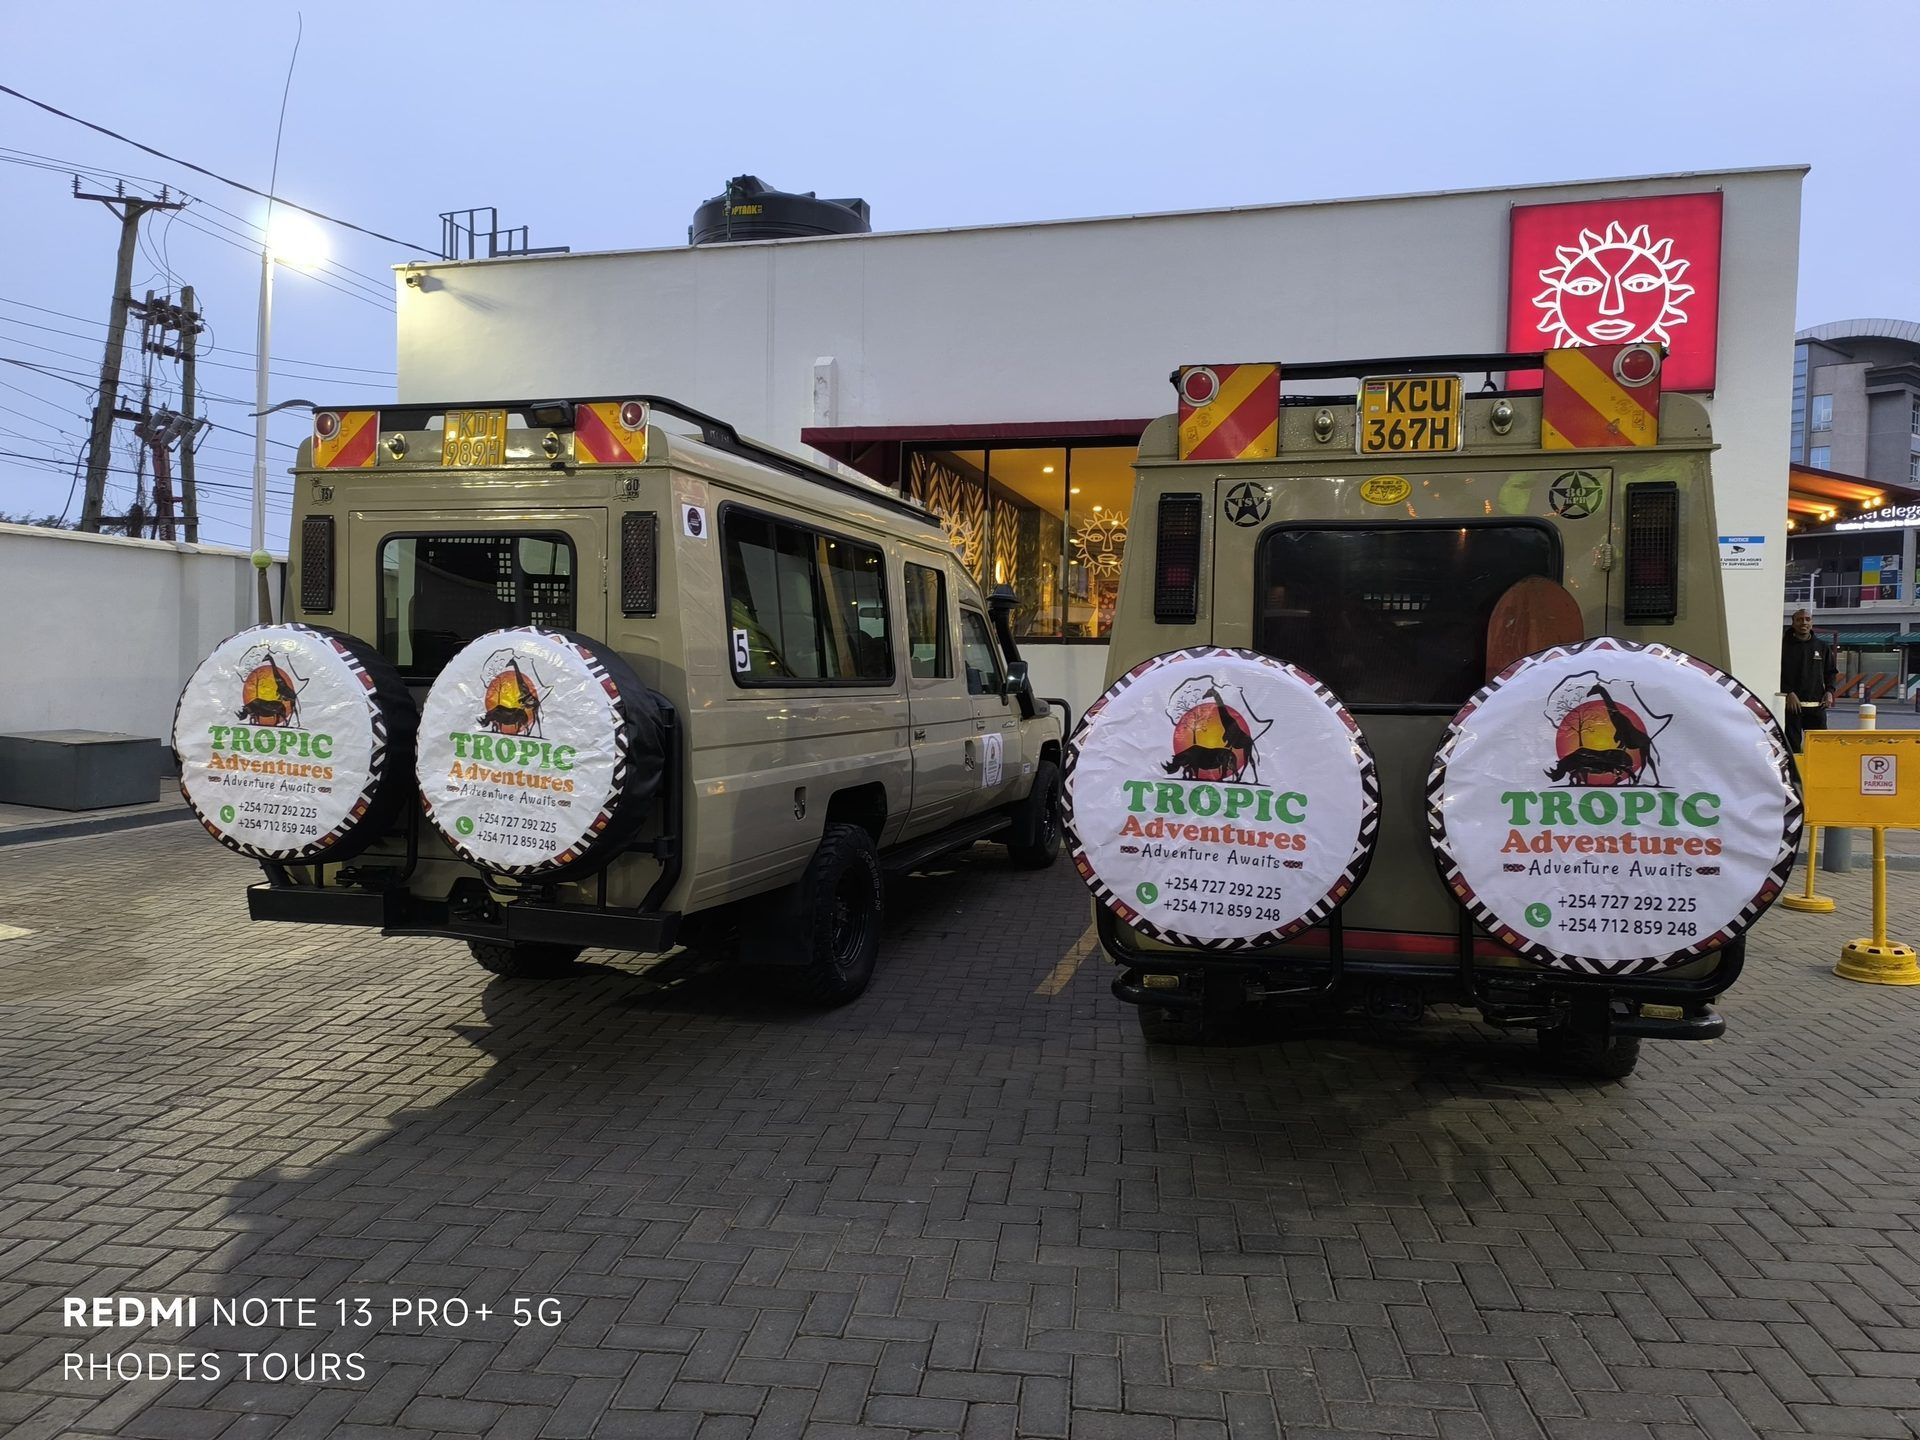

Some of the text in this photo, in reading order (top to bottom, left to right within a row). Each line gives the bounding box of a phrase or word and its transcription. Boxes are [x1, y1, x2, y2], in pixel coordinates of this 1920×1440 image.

[1387, 380, 1451, 413] KCU
[460, 412, 502, 438] KDT
[1368, 417, 1450, 450] 367H
[445, 441, 500, 466] 989H
[1235, 497, 1262, 507] TSV
[1565, 488, 1586, 497] 80
[736, 633, 748, 669] 5
[208, 725, 333, 759] TROPIC
[449, 732, 576, 771] TROPIC
[207, 752, 333, 780] Adventures
[448, 760, 574, 793] Adventures
[222, 774, 316, 794] Adventure Awaits
[460, 784, 556, 807] Adventure Awaits
[238, 801, 318, 819] +254 727 292 225
[1123, 779, 1308, 824] TROPIC
[1500, 790, 1721, 827] TROPIC
[238, 818, 318, 835] +254 712 859 248
[478, 812, 557, 833] +254 727 292 225
[1118, 814, 1307, 851] Adventures
[477, 831, 557, 851] +254 712 859 248
[1500, 829, 1722, 856] Adventures
[1141, 843, 1280, 869] Adventure Awaits
[1529, 859, 1693, 878] Adventure Awaits
[1165, 877, 1281, 900] +254 727 292 225
[1164, 898, 1280, 922] +254 712 859 248
[1558, 894, 1697, 912] +254 727 292 225
[1558, 917, 1697, 937] +254 712 859 248
